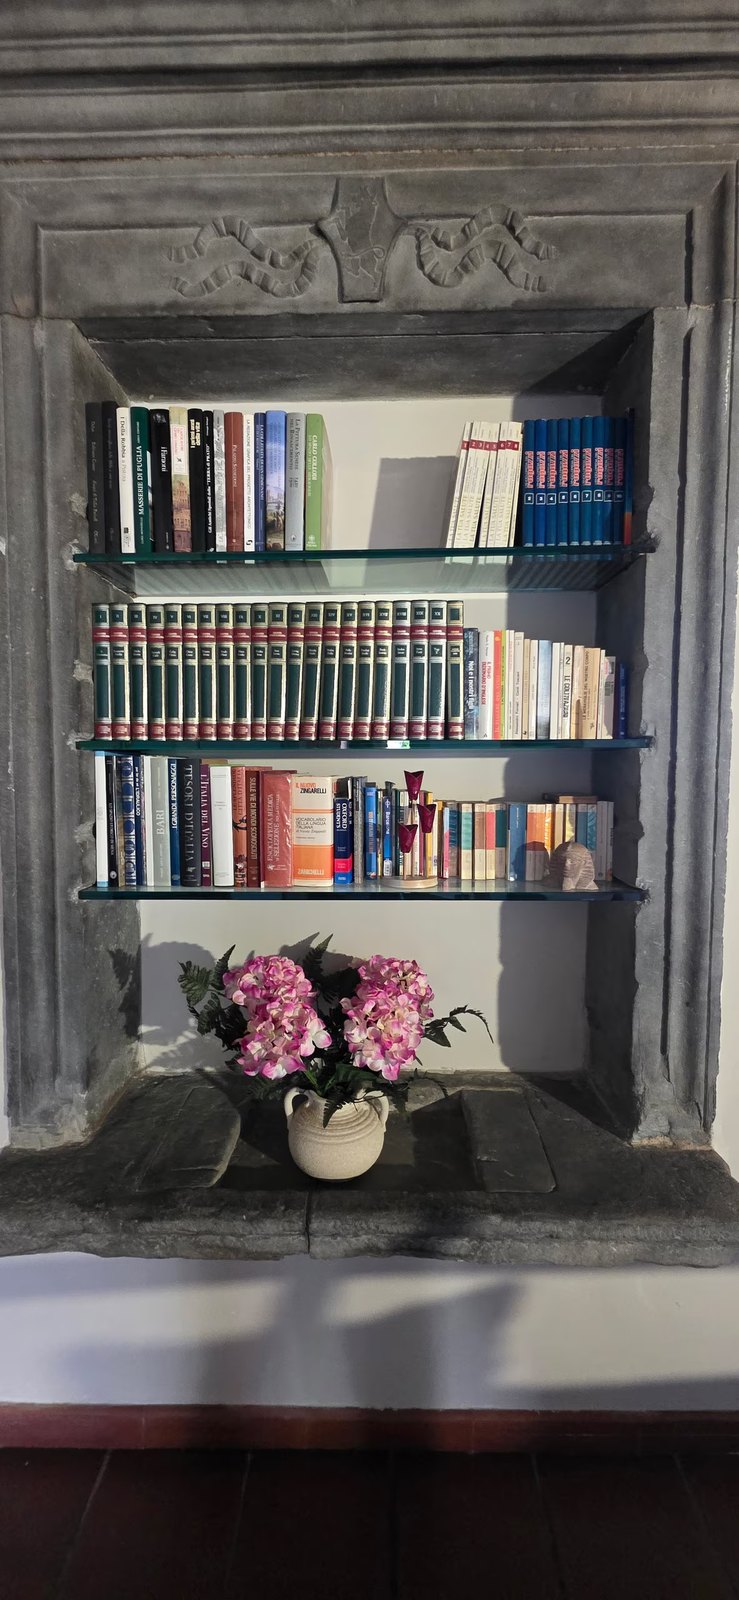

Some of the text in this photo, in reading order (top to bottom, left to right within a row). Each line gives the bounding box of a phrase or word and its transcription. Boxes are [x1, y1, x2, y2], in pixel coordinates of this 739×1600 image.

[200, 774, 209, 807] L'ITALIA
[156, 810, 165, 835] BARI
[184, 765, 194, 861] TESORI D'ITALIA
[202, 828, 210, 848] VINO
